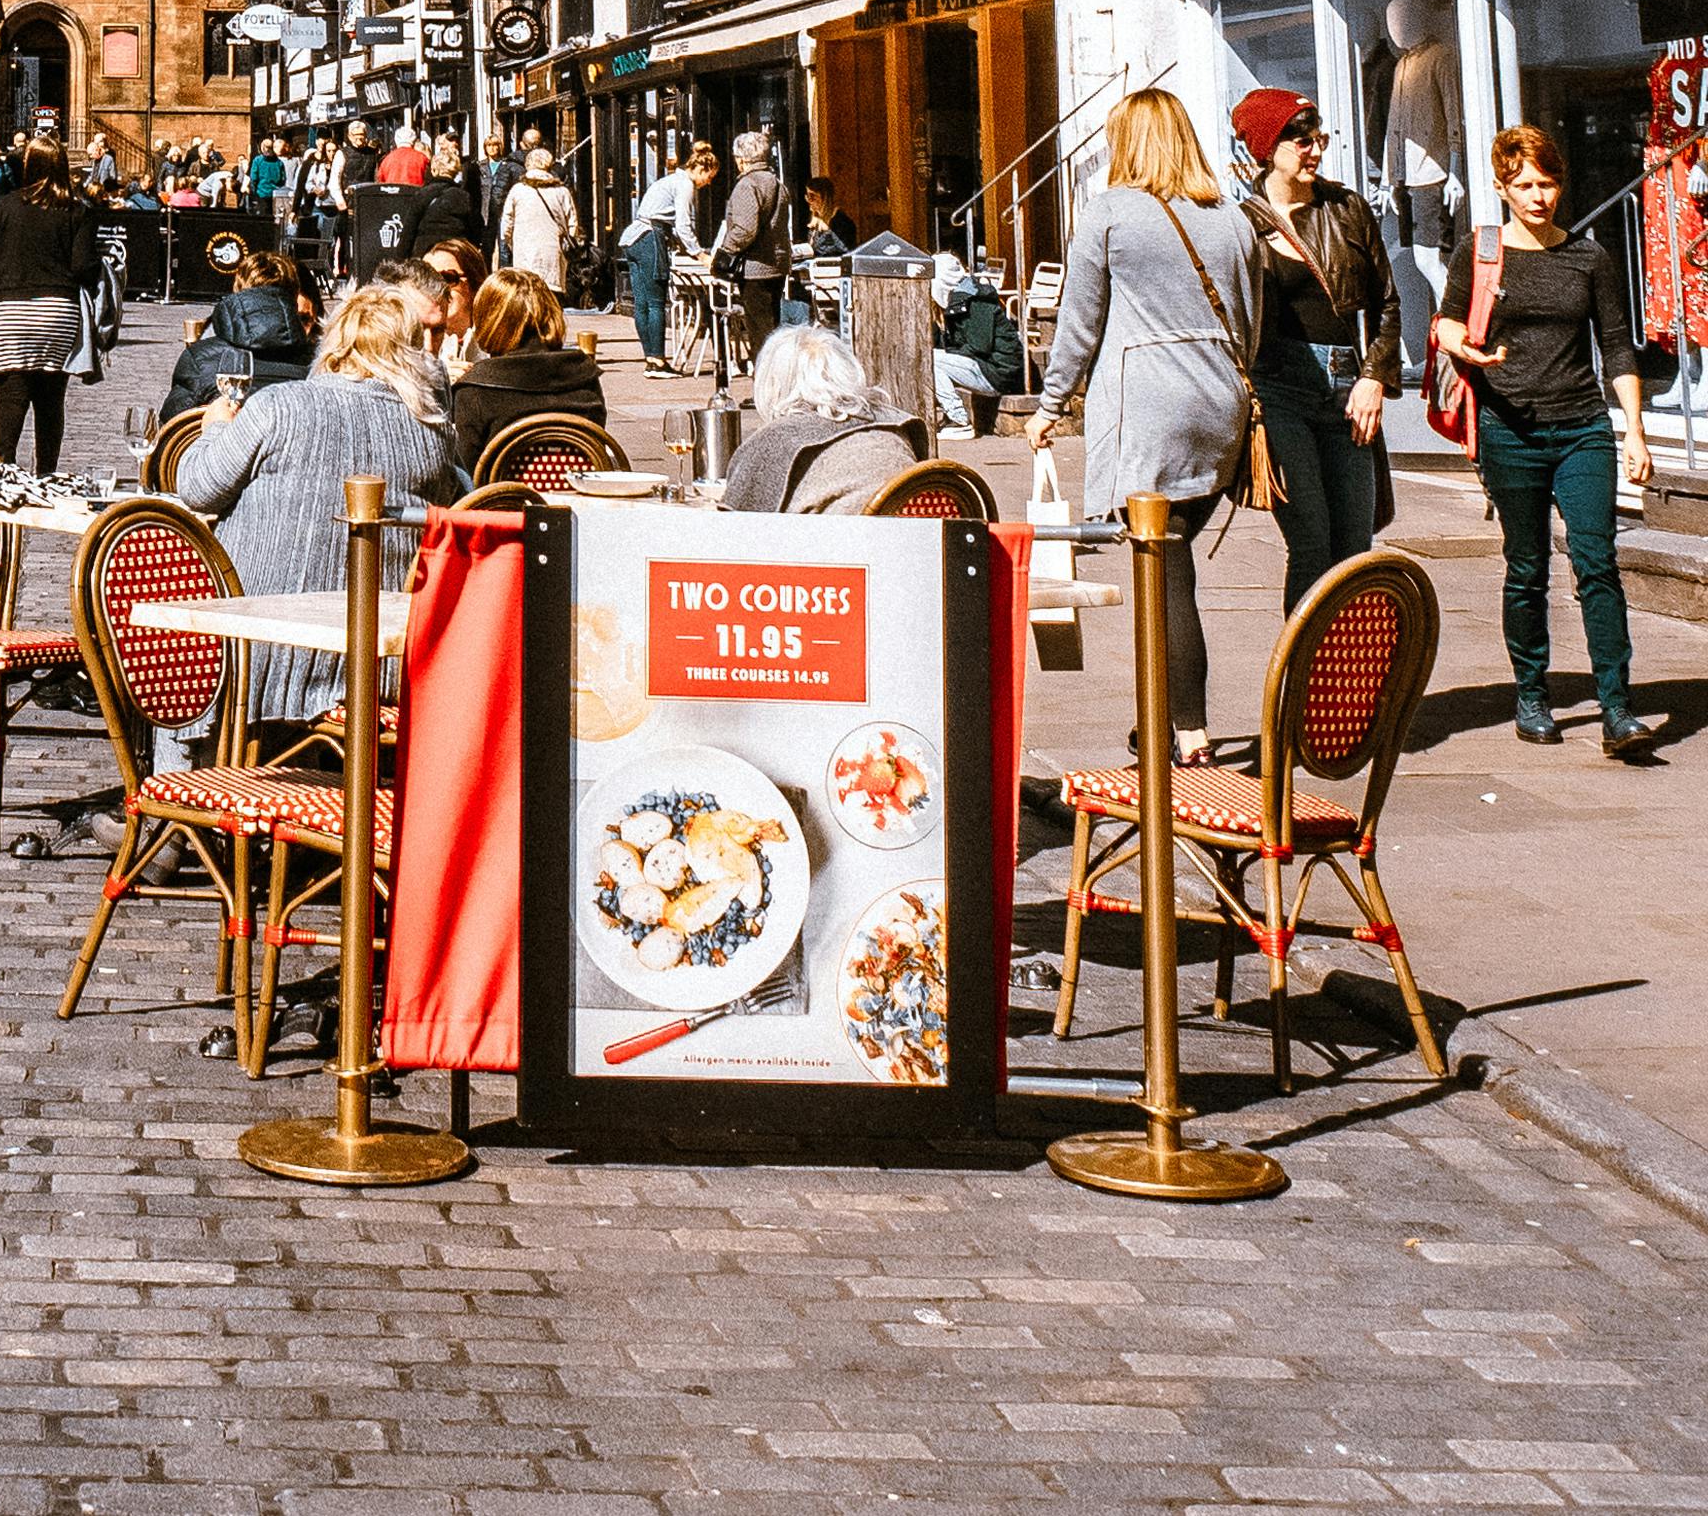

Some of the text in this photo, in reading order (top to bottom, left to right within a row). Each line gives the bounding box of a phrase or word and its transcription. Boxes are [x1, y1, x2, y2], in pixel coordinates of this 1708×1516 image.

[1667, 38, 1696, 60] MID
[34, 109, 57, 118] OPEN
[667, 581, 851, 615] TWO COURSES
[715, 623, 803, 659] 11.95
[685, 667, 830, 685] THREE COURSES 14.95
[683, 1055, 724, 1066] Allergen
[756, 1056, 799, 1066] available
